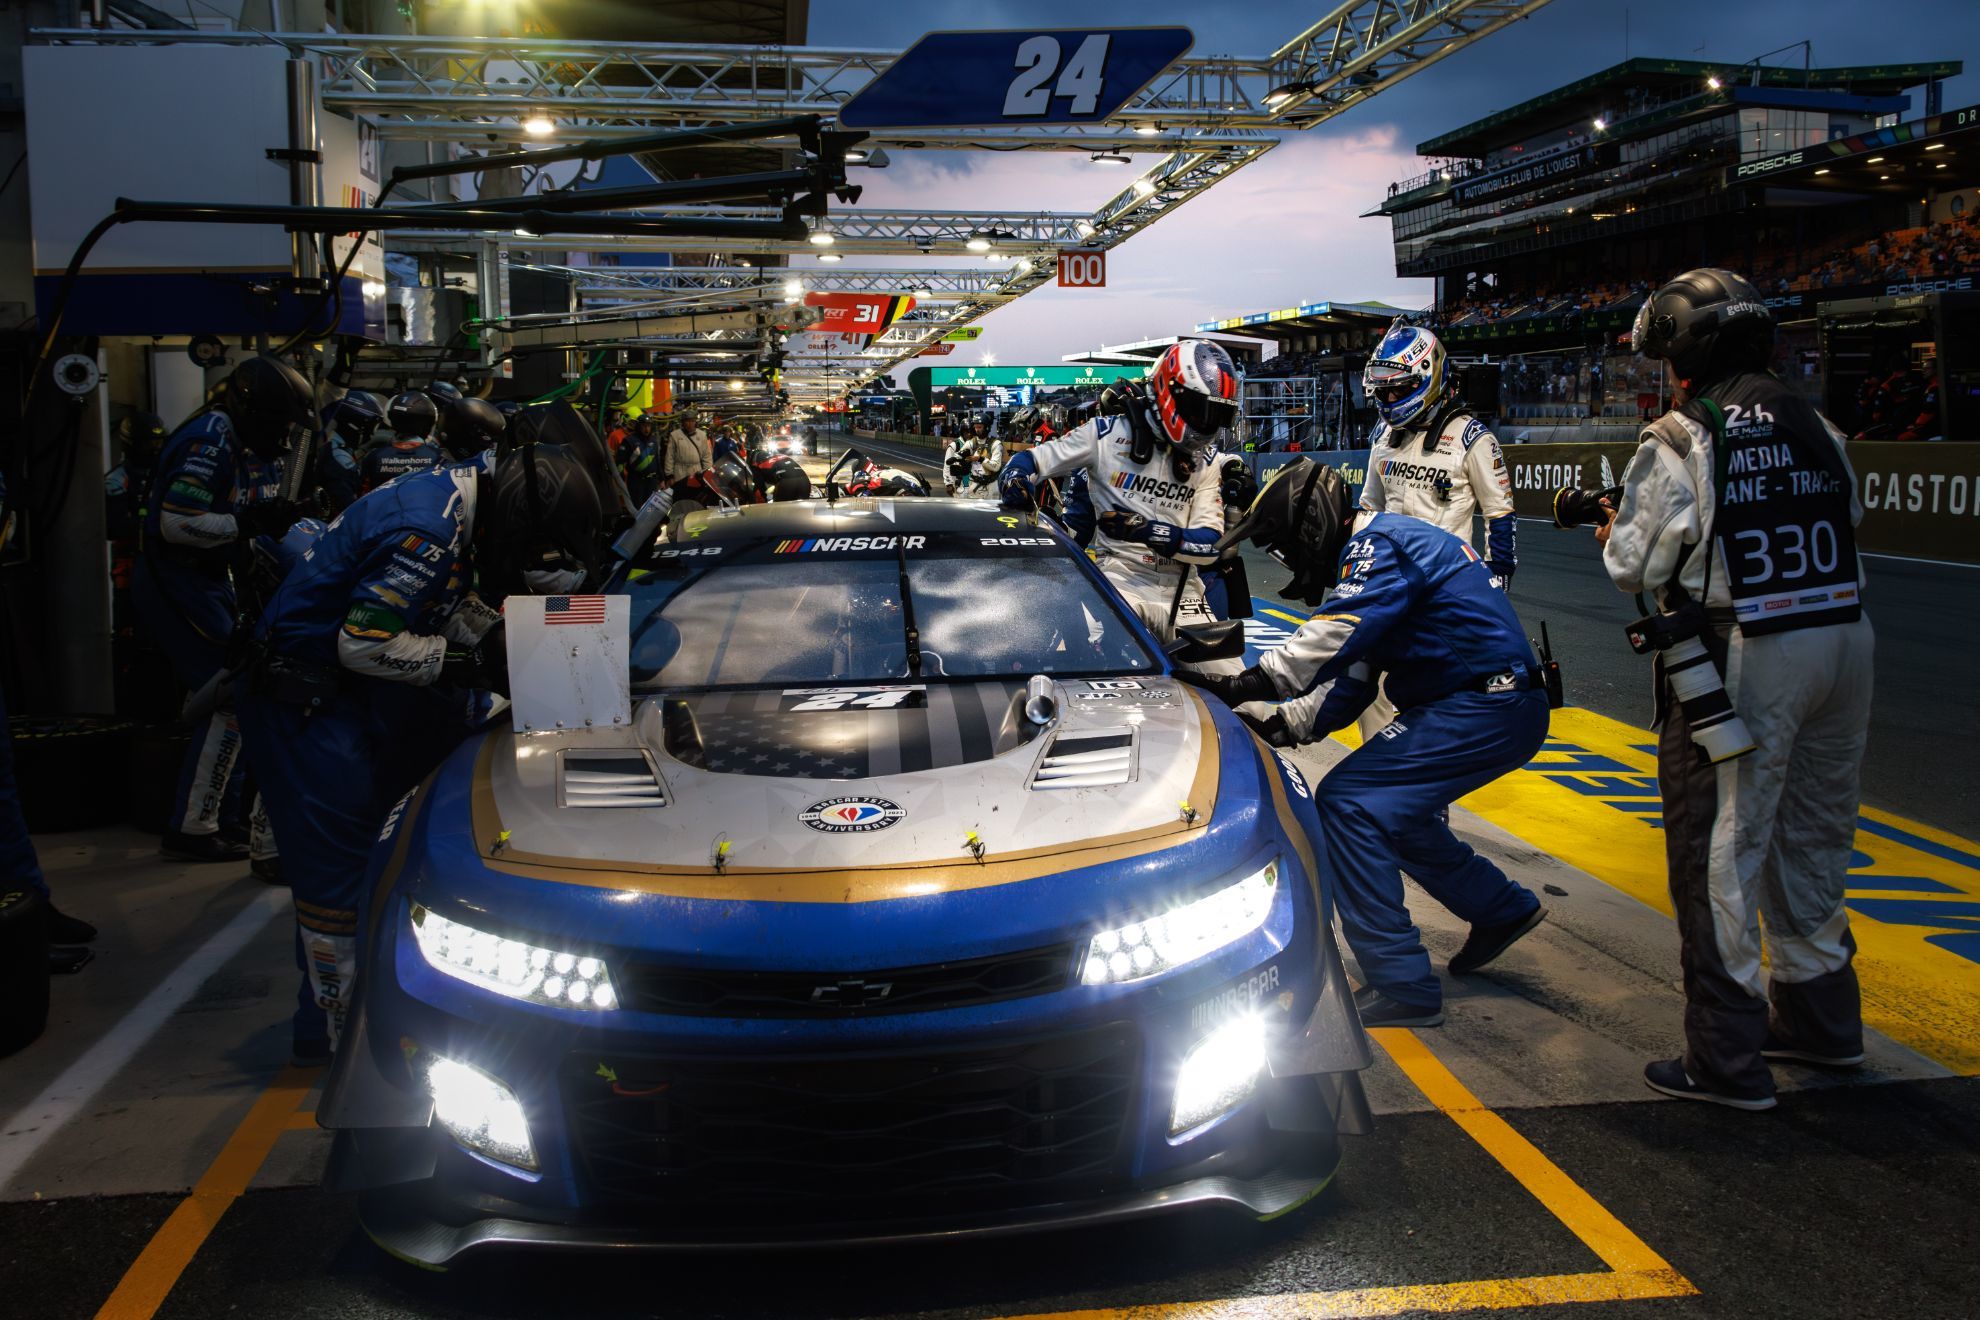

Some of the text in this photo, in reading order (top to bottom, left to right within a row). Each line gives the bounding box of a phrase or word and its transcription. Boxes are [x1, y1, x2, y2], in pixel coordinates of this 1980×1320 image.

[1002, 34, 1111, 116] 24
[1737, 152, 1804, 177] PORSCHE
[1464, 152, 1583, 200] AUTOMOBILE CLUB DE L'OUEST
[1060, 254, 1103, 285] 100
[1886, 277, 1973, 297] PORSCHE
[1765, 295, 1803, 309] SCHE
[853, 304, 880, 323] 31
[840, 331, 861, 345] 41
[1723, 403, 1775, 429] 24h
[1725, 428, 1741, 439] LE
[1741, 422, 1775, 437] MANS
[204, 444, 221, 457] 75
[1727, 442, 1795, 476] MEDIA
[1389, 461, 1448, 482] NASCAR
[1515, 463, 1582, 490] CASTORE
[1131, 474, 1196, 505] NASCAR
[1384, 477, 1392, 485] TO
[1408, 482, 1434, 492] MANS
[1723, 475, 1768, 506] ANE
[1122, 491, 1185, 512] TO LE MANS
[811, 535, 927, 553] NASCAR
[979, 537, 1056, 547] 2023
[421, 543, 447, 563] 75
[650, 546, 723, 560] 1948
[1354, 560, 1374, 574] 75
[789, 690, 912, 712] 24
[208, 734, 238, 793] NASCAR
[813, 797, 892, 811] NASCAR 75TH
[810, 816, 894, 832] ANNIVERSARY
[1214, 964, 1280, 1012] NASCAR
